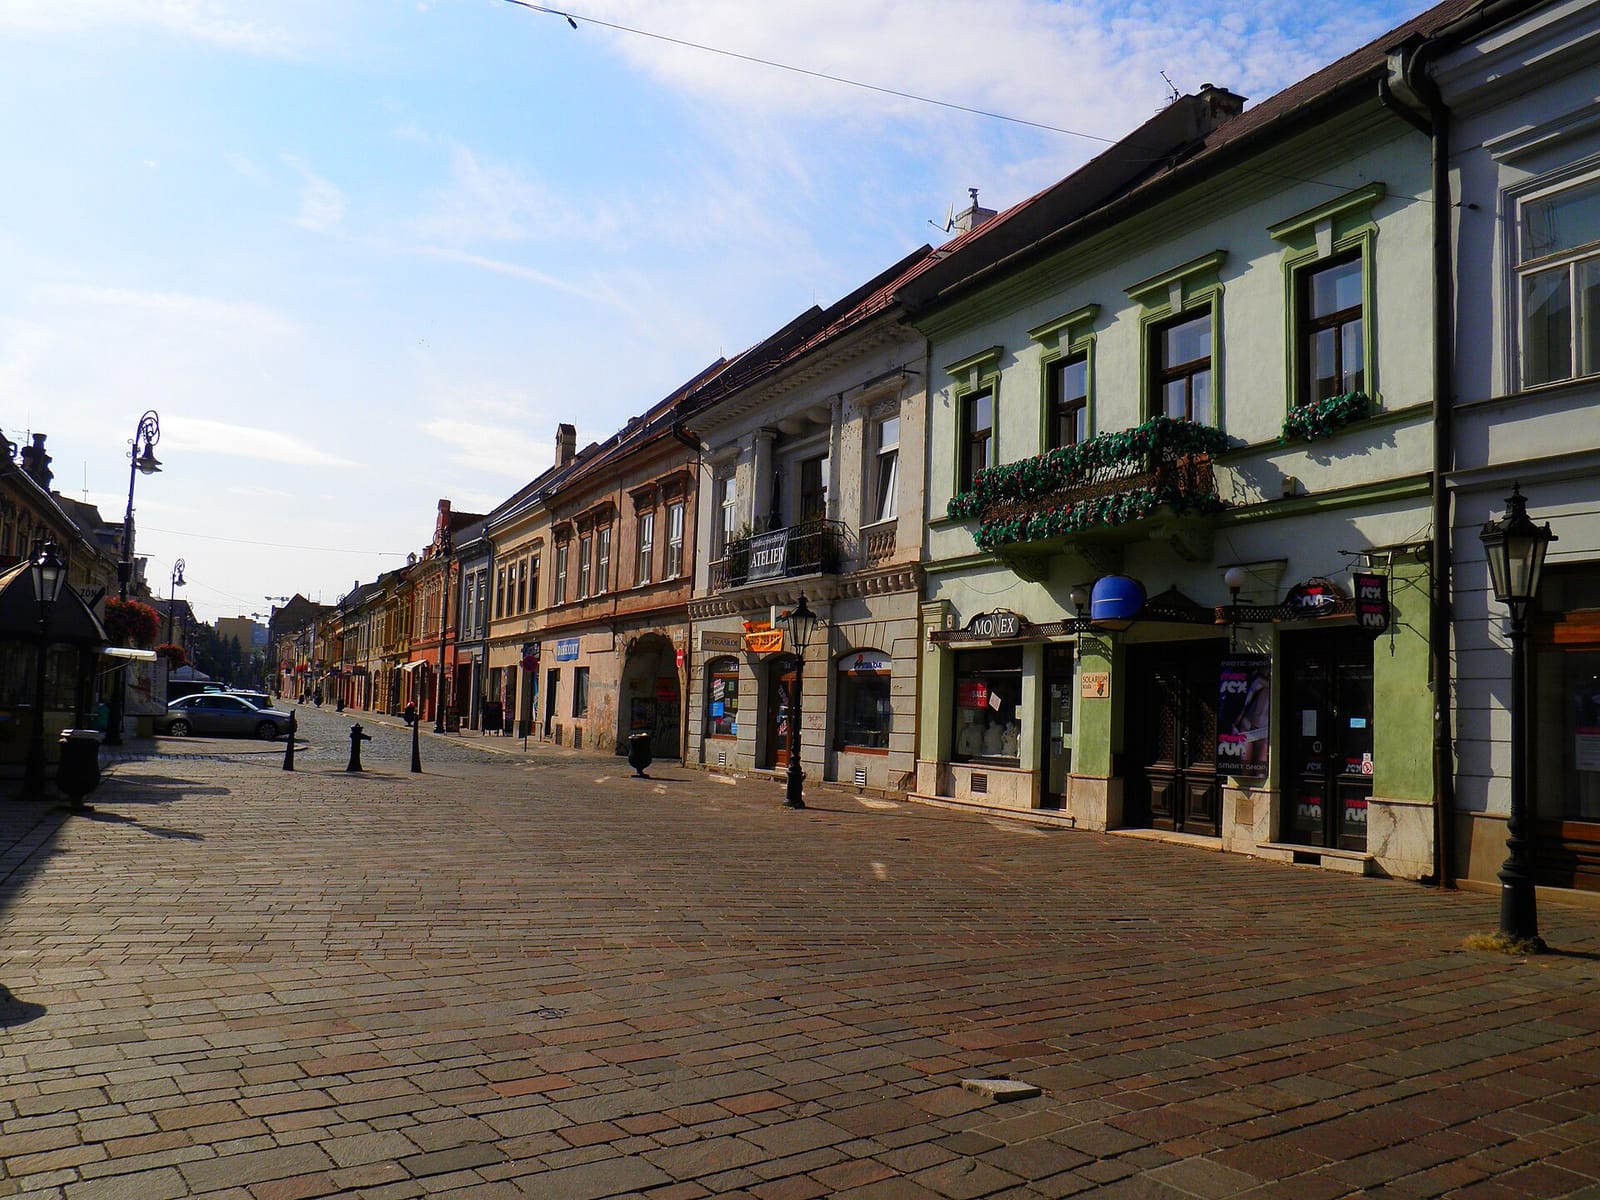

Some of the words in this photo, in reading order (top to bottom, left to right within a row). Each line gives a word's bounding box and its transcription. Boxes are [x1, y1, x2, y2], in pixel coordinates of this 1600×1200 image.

[750, 546, 784, 568] ATELIER
[974, 615, 1015, 637] MONEX
[1082, 675, 1107, 683] SOLARIUM
